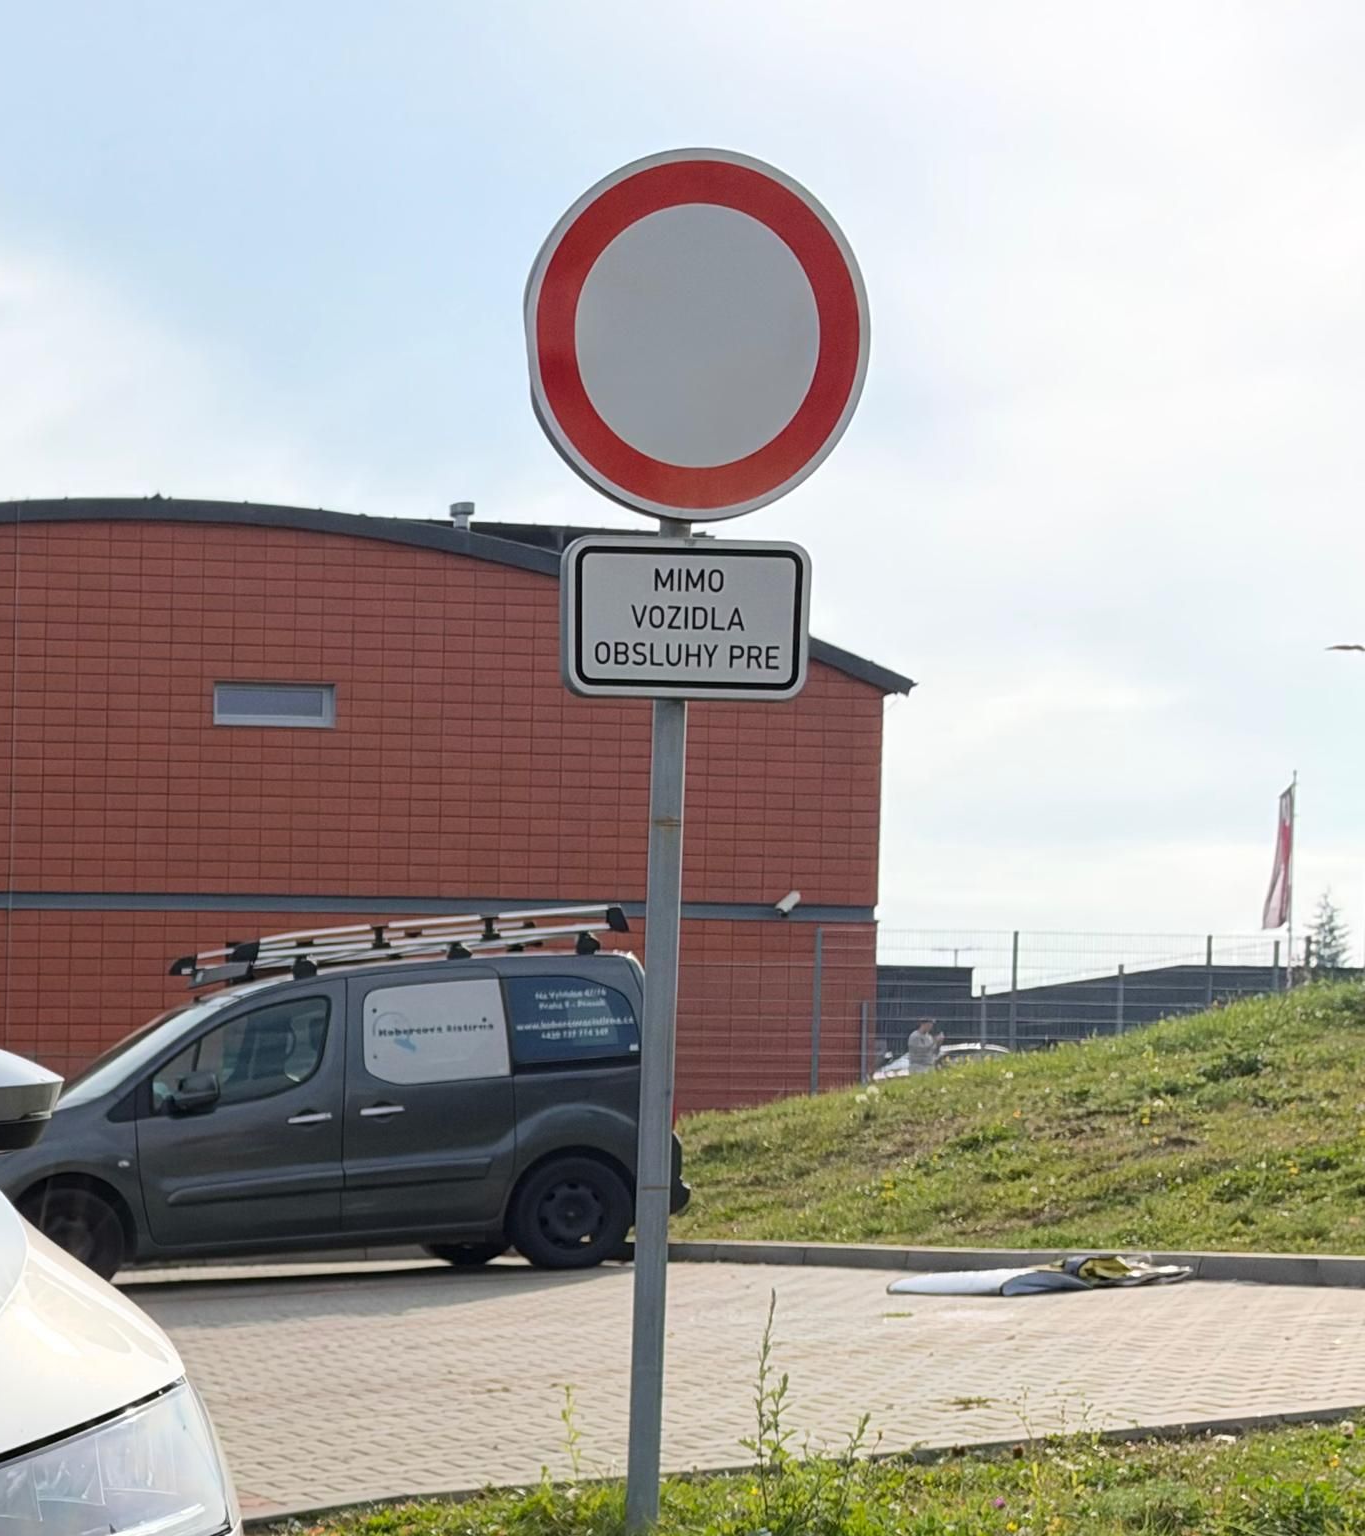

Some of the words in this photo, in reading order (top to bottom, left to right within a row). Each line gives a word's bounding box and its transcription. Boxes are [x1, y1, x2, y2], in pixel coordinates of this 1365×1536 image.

[653, 567, 725, 593] MIMO
[631, 604, 745, 632] VOZIDLA
[594, 641, 719, 669] OBSLUHY
[728, 645, 781, 670] PRE
